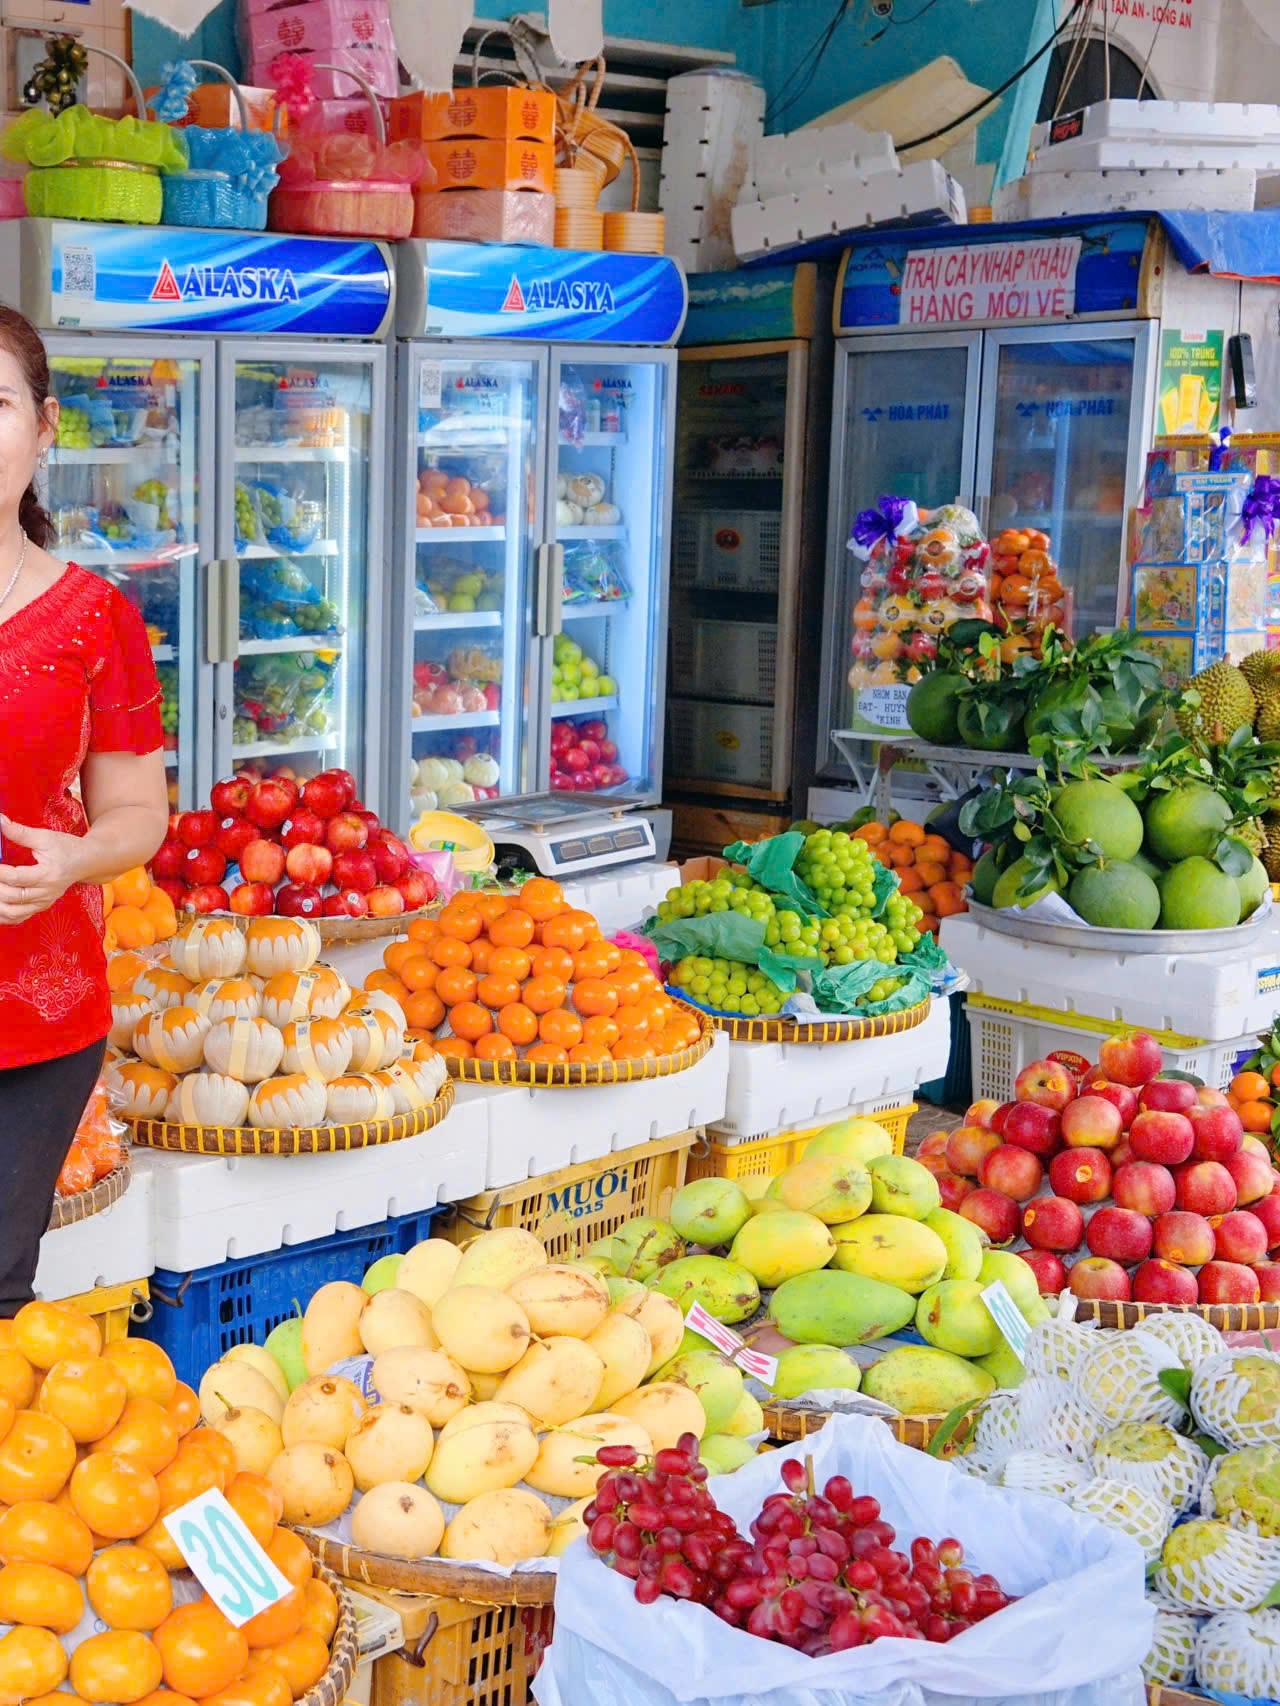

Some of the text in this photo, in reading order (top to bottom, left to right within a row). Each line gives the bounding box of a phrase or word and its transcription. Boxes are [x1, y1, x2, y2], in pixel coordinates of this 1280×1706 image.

[1131, 2, 1145, 18] AN
[1152, 6, 1177, 26] LONG
[1179, 11, 1192, 29] AN
[183, 264, 299, 301] ALASKA
[905, 248, 942, 289] TRÁI
[526, 279, 615, 312] ALASKA
[910, 282, 1066, 323] HÀNG MỚI VỀ
[109, 376, 153, 387] ALASKA
[464, 378, 498, 388] ALASKA
[602, 378, 632, 389] ALASKA
[568, 1199, 604, 1218] 015
[178, 1504, 279, 1617] 30
